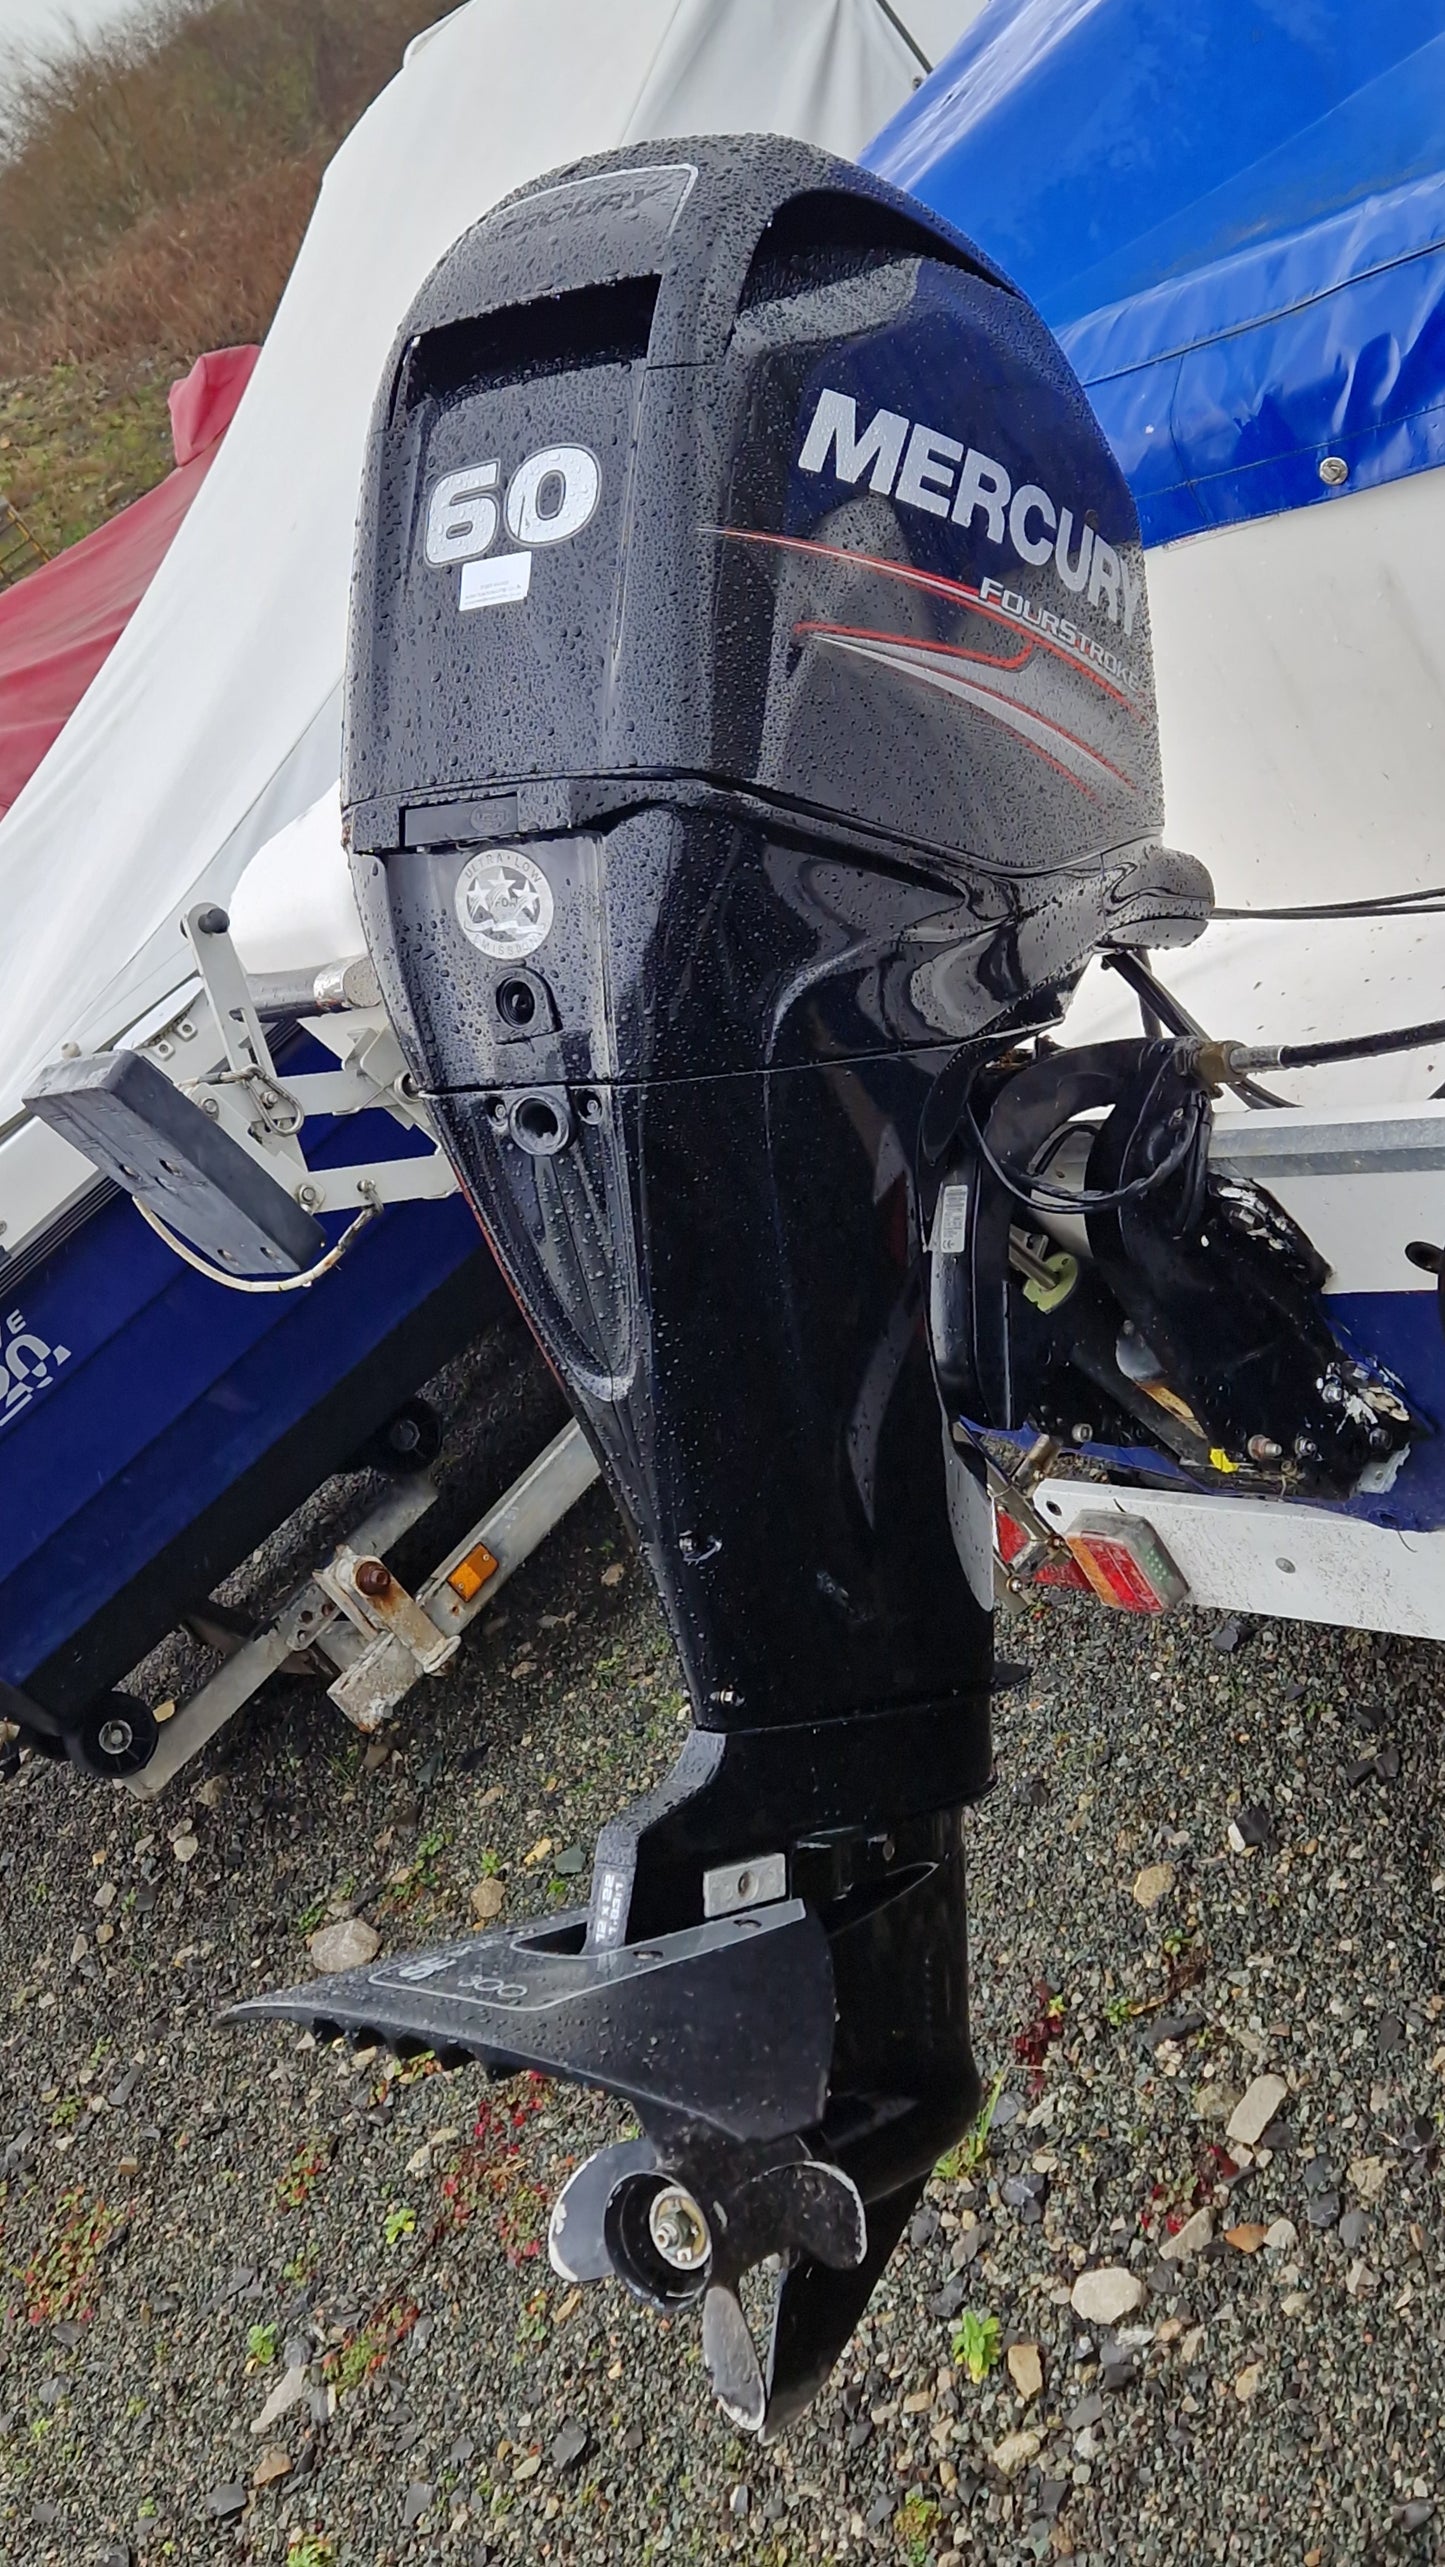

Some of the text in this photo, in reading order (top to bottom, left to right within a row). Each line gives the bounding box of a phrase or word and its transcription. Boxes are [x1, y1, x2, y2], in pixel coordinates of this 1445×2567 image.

[424, 442, 602, 569] 60
[797, 387, 1142, 637] MERCURY
[978, 576, 1141, 693] FOURSTROKE
[464, 852, 543, 884] ULTRA LOW
[594, 1920, 608, 1944] 12
[601, 1873, 616, 1902] 22
